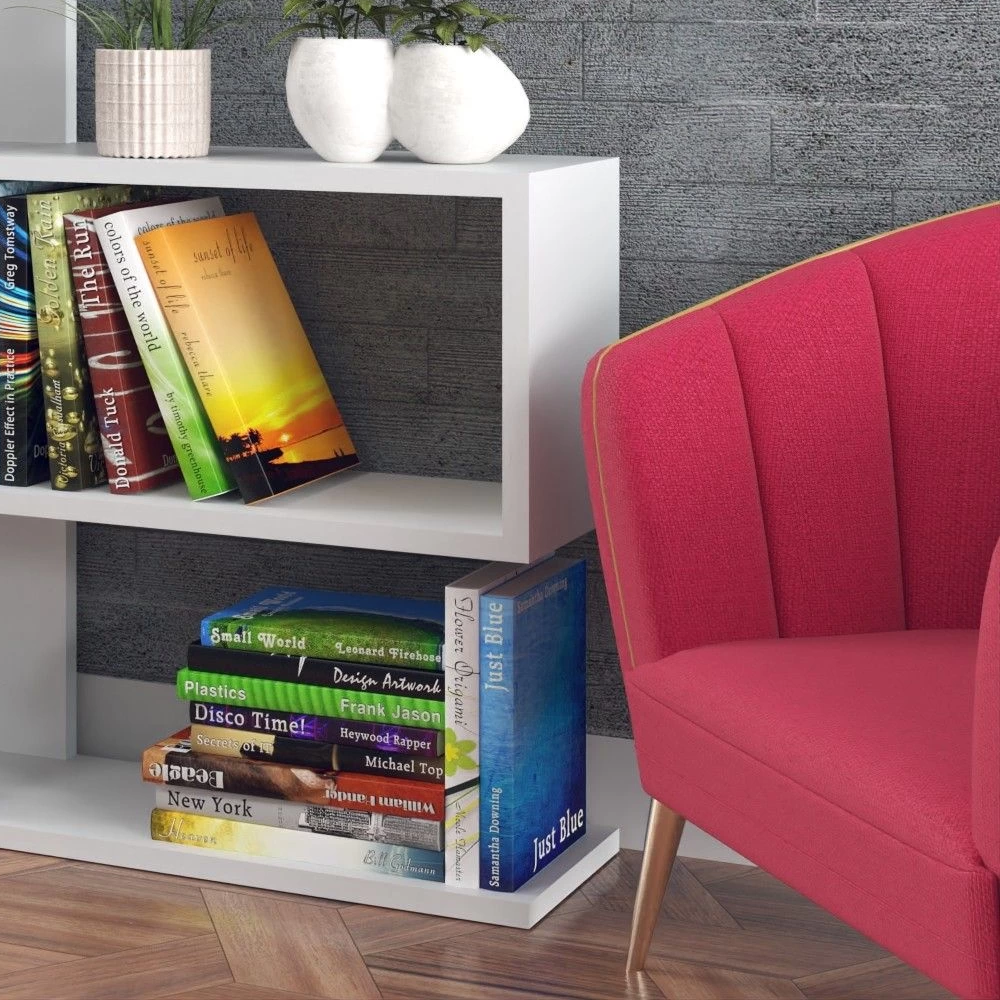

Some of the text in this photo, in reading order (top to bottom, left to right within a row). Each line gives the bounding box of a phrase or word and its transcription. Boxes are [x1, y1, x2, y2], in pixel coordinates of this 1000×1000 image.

[5, 205, 18, 290] Greg Tomstway
[31, 200, 63, 324] Golden Rain
[194, 226, 254, 264] sunset of life
[74, 220, 100, 307] The Run
[143, 240, 190, 314] sunset of life
[104, 221, 161, 353] colors of the world
[182, 332, 200, 367] rebecca
[5, 348, 17, 482] Doppler Effect in Practice
[100, 387, 129, 489] Donald Tuck
[167, 391, 208, 494] by timothy greenhouse
[57, 441, 69, 484] Victoria
[211, 627, 306, 650] Small World
[335, 641, 442, 663] Leonard Firehose
[482, 602, 511, 695] Just Blue
[448, 597, 480, 726] Flower Origami
[184, 681, 247, 701] Plastics
[333, 666, 442, 694] Design Artwork
[194, 703, 305, 735] Disco Time!
[340, 698, 441, 724] Frank Jason
[197, 734, 239, 750] Secrets
[243, 741, 256, 752] of
[340, 727, 432, 750] Heywood Rapper
[149, 762, 224, 789] Beagle
[365, 755, 444, 779] Michael Top
[168, 790, 252, 817] New York
[378, 796, 435, 814] William
[489, 787, 503, 888] Samantha Downing
[533, 807, 584, 872] Just Blue
[363, 849, 388, 865] Bill
